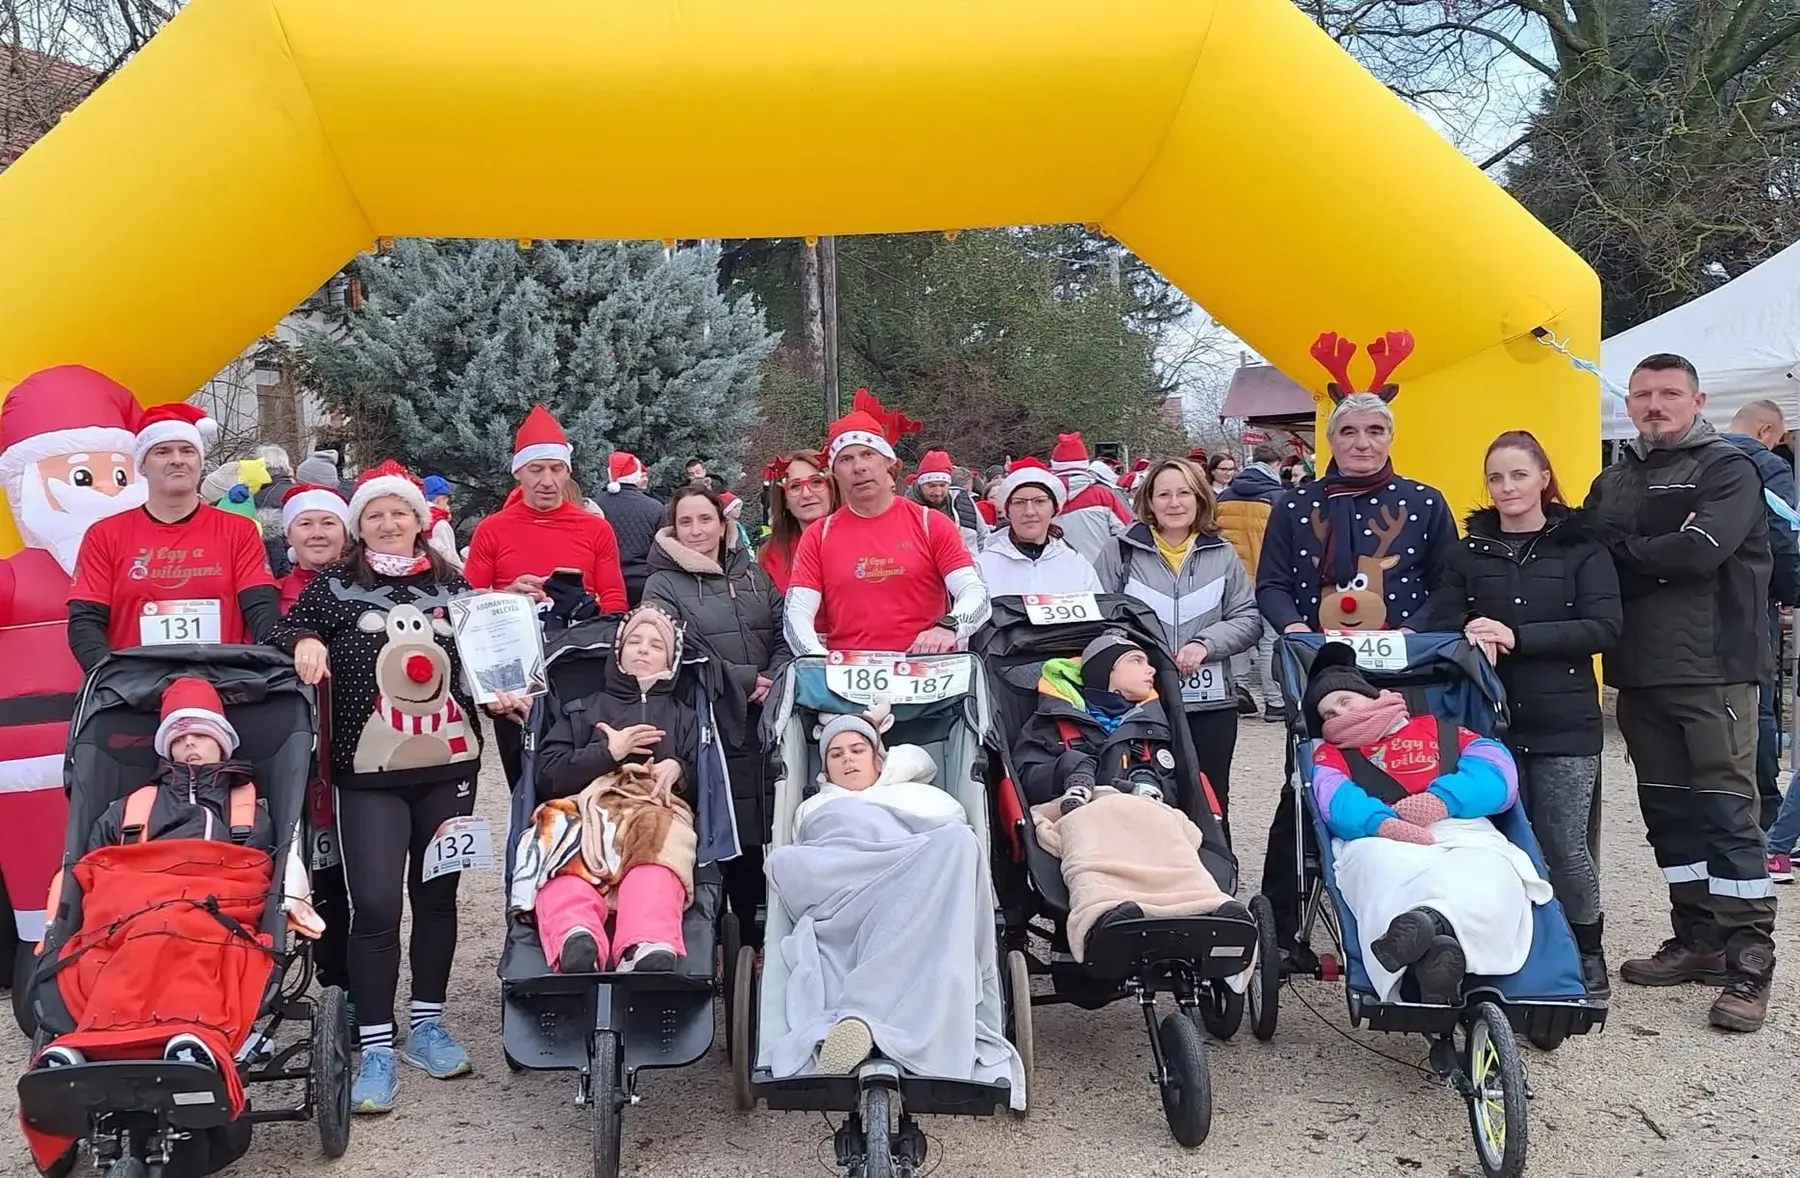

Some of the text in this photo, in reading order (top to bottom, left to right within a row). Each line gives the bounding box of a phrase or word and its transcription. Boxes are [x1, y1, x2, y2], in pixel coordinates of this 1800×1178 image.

[1040, 604, 1087, 620] 390
[160, 616, 201, 640] 131
[843, 668, 889, 691] 186
[910, 673, 955, 694] 187
[1391, 737, 1424, 752] Egy
[434, 833, 476, 862] 132
